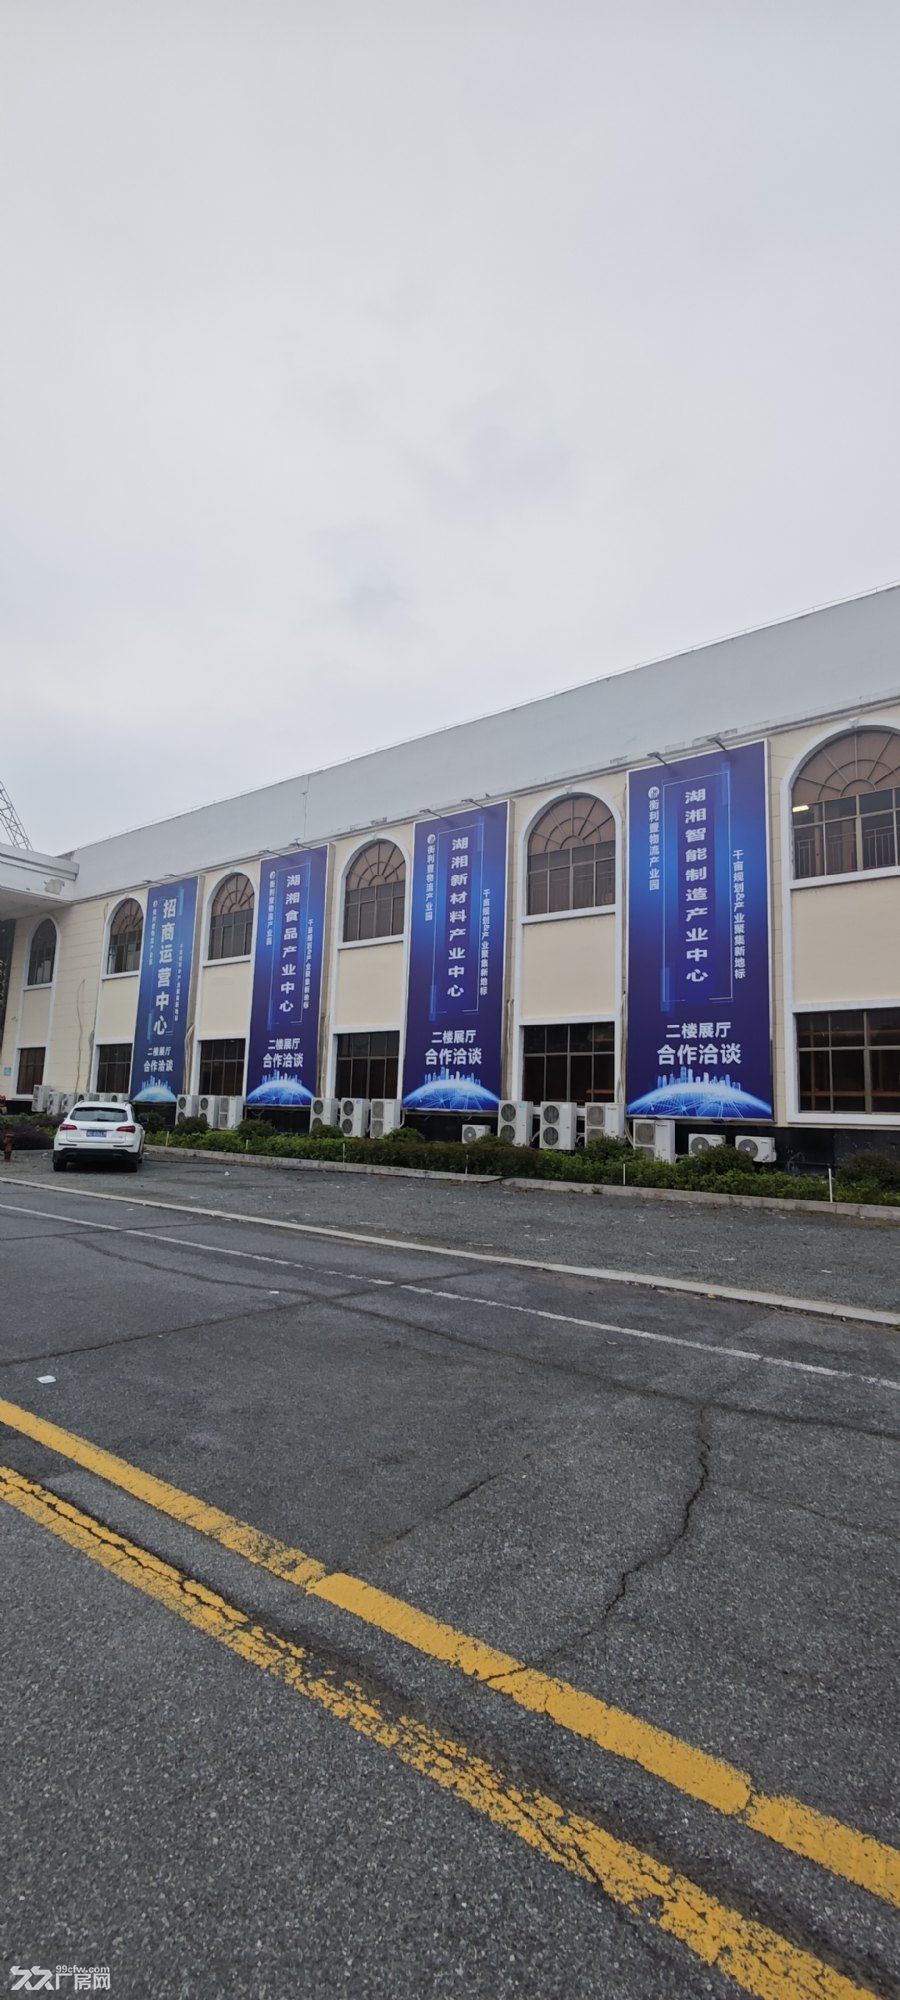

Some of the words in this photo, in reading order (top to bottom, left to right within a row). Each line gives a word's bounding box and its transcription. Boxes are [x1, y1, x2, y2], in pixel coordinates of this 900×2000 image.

[684, 788, 709, 982] 湖湘智能制造产业中心
[447, 836, 469, 998] 湖湘新材料产业中心
[279, 874, 301, 1013] 湖湘食品产业中心
[153, 898, 177, 1035] 招商运营中心
[431, 1030, 477, 1044] 二楼展厅
[666, 1022, 732, 1039] 二楼展厅
[268, 1038, 301, 1050] 二楼展厅
[263, 1053, 304, 1069] 合作洽谈
[425, 1047, 482, 1066] 合作洽谈
[657, 1043, 742, 1066] 合作洽谈
[143, 1059, 174, 1073] 合作洽谈
